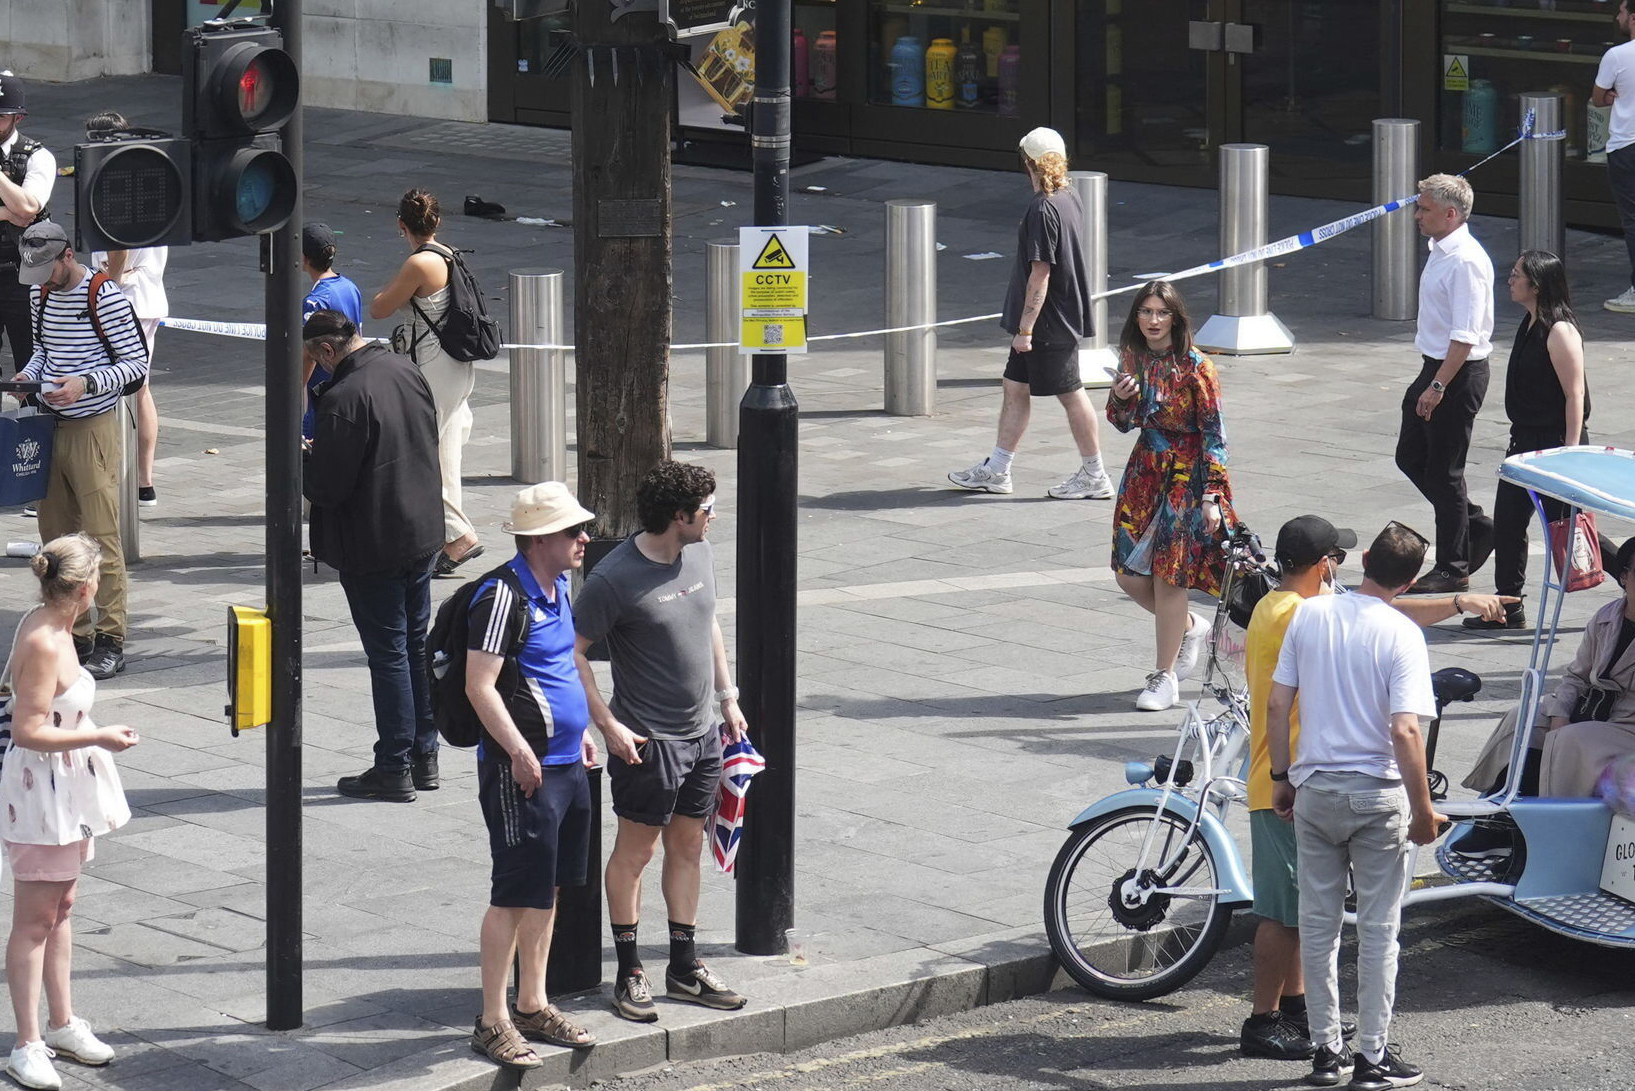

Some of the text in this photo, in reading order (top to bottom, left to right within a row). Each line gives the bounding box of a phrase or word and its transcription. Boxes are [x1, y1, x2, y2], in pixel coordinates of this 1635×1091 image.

[1354, 215, 1365, 227] LINE
[1364, 209, 1382, 223] POLICE
[1318, 224, 1336, 240] CROSS
[1335, 220, 1346, 235] NOT
[756, 274, 791, 285] CCTV
[213, 322, 223, 333] DO
[225, 322, 240, 335] LINE
[241, 324, 266, 338] POLICE
[12, 459, 41, 473] Whittard
